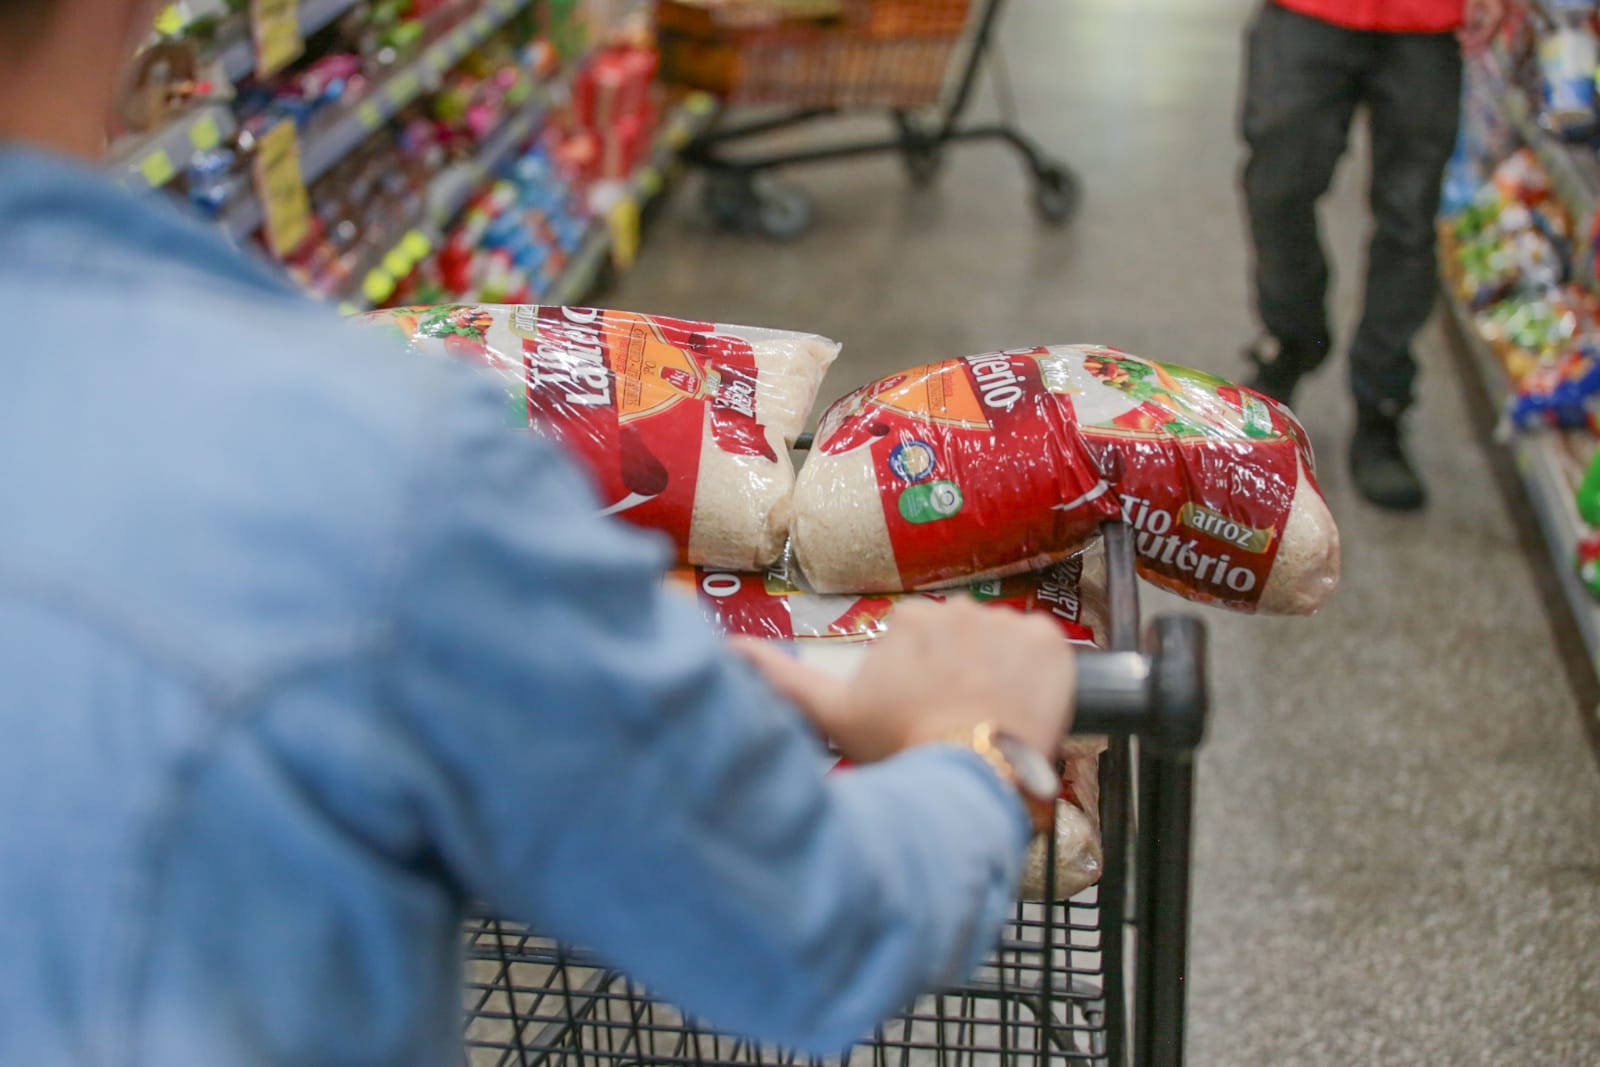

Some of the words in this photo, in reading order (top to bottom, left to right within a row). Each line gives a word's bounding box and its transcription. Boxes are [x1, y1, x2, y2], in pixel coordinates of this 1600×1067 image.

[1120, 494, 1172, 535] Tio
[1192, 509, 1253, 547] arroz
[1137, 531, 1256, 592] utério
[1037, 581, 1059, 602] Tio
